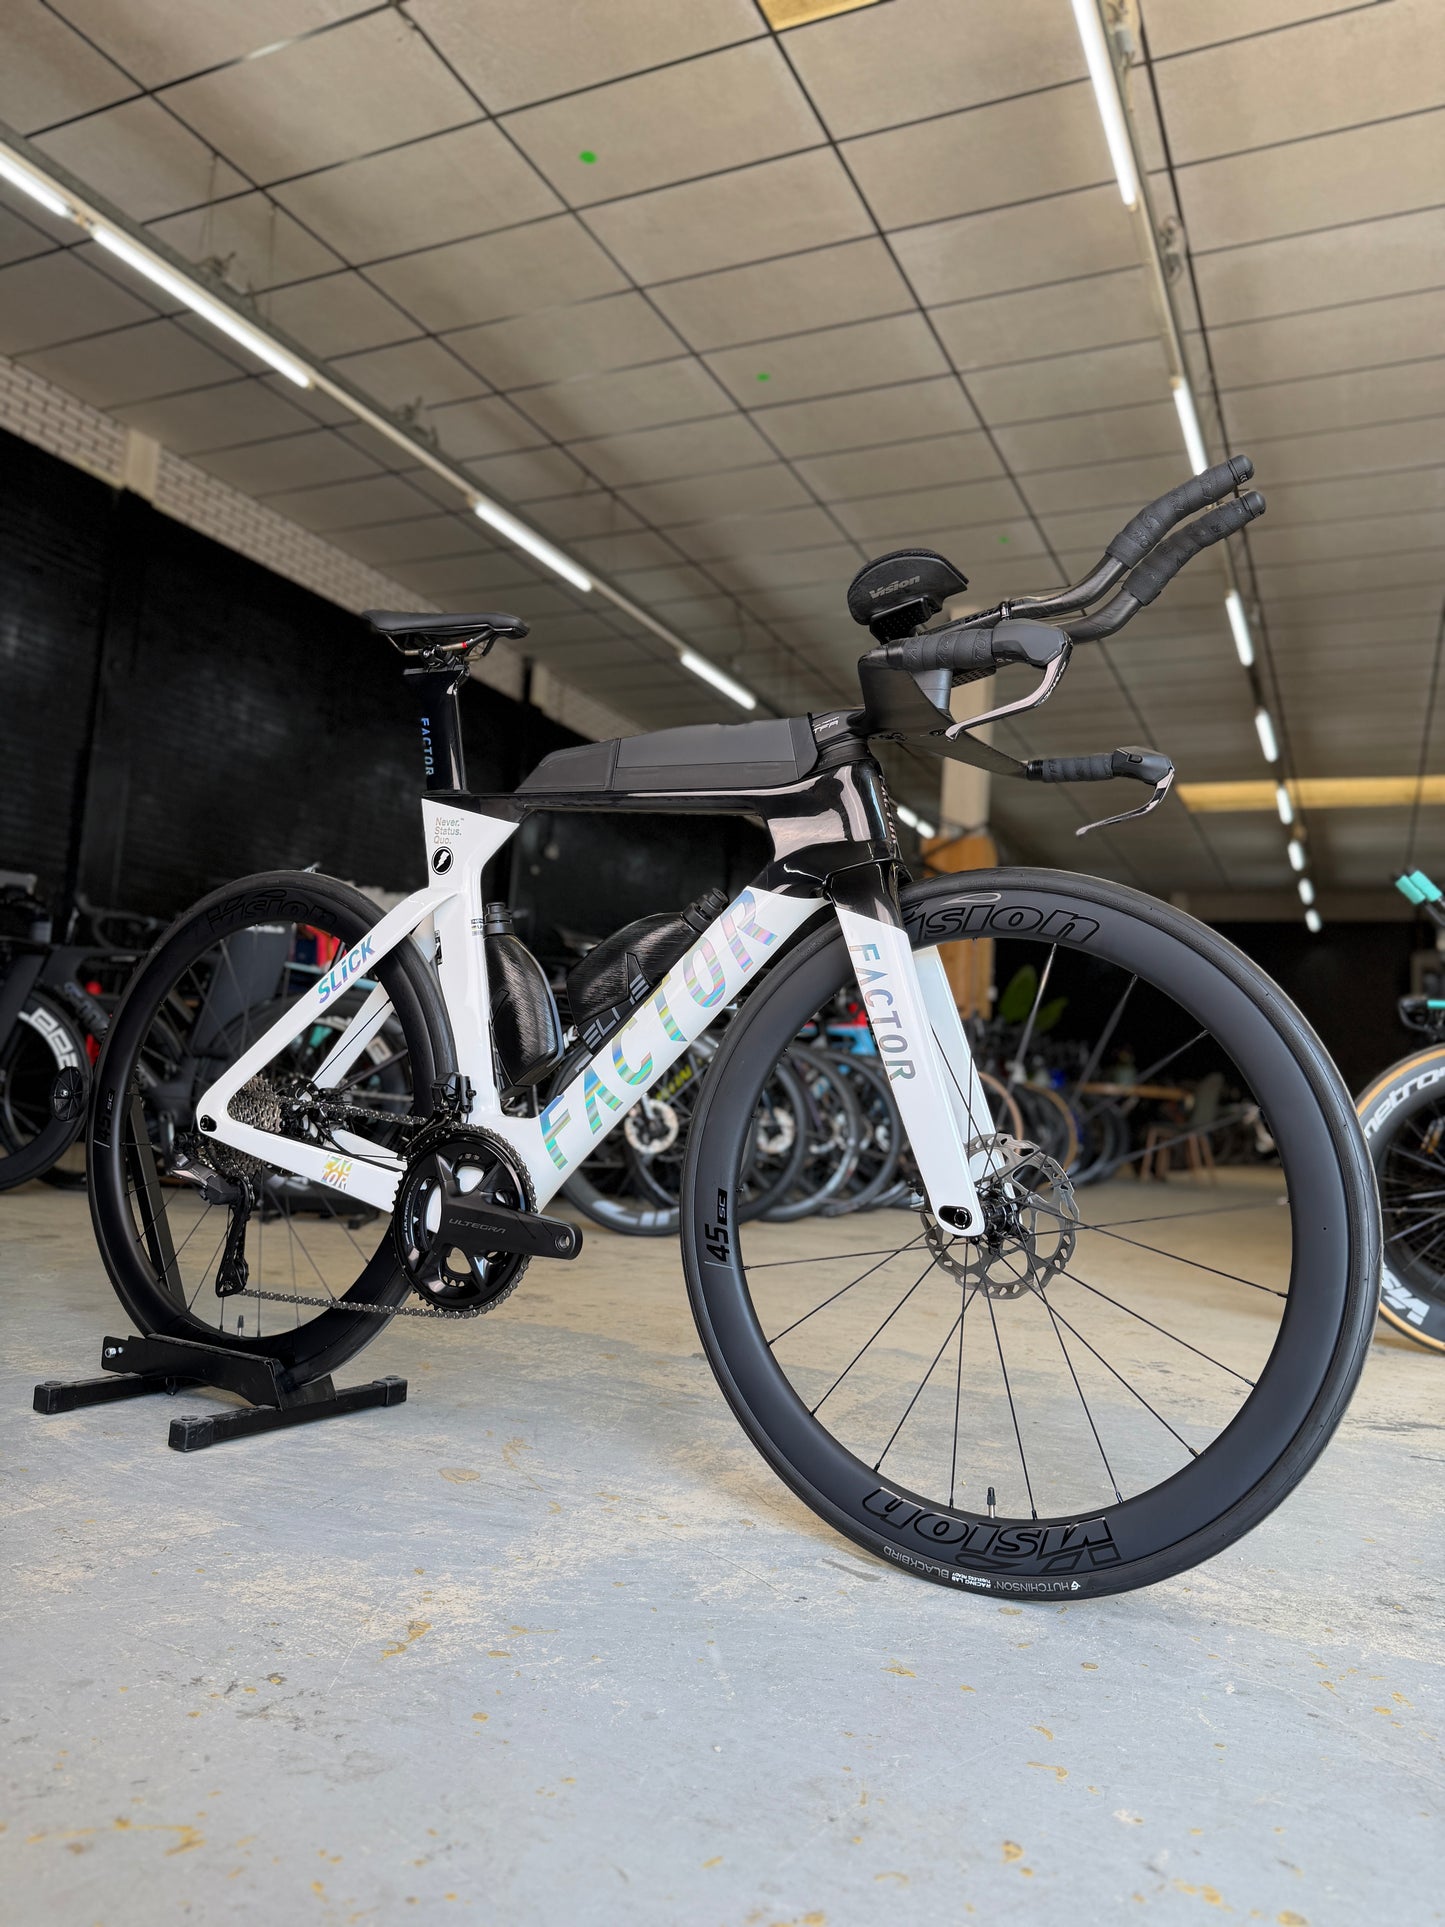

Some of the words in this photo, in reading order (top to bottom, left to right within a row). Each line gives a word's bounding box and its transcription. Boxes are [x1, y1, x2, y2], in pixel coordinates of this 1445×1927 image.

[868, 575, 921, 599] Vision
[420, 717, 435, 776] FACTOR
[433, 836, 452, 845] Quo.
[434, 826, 462, 837] Status.
[848, 943, 916, 1081] FACTOR
[539, 890, 780, 1171] FACTOR
[449, 1218, 507, 1235] ULTEGRA
[704, 1224, 731, 1262] 45
[718, 1195, 727, 1219] SC
[860, 1486, 1122, 1574] Vision
[883, 1545, 950, 1579] BLACKBIRD
[994, 1580, 1070, 1592] HUTCHINSON
